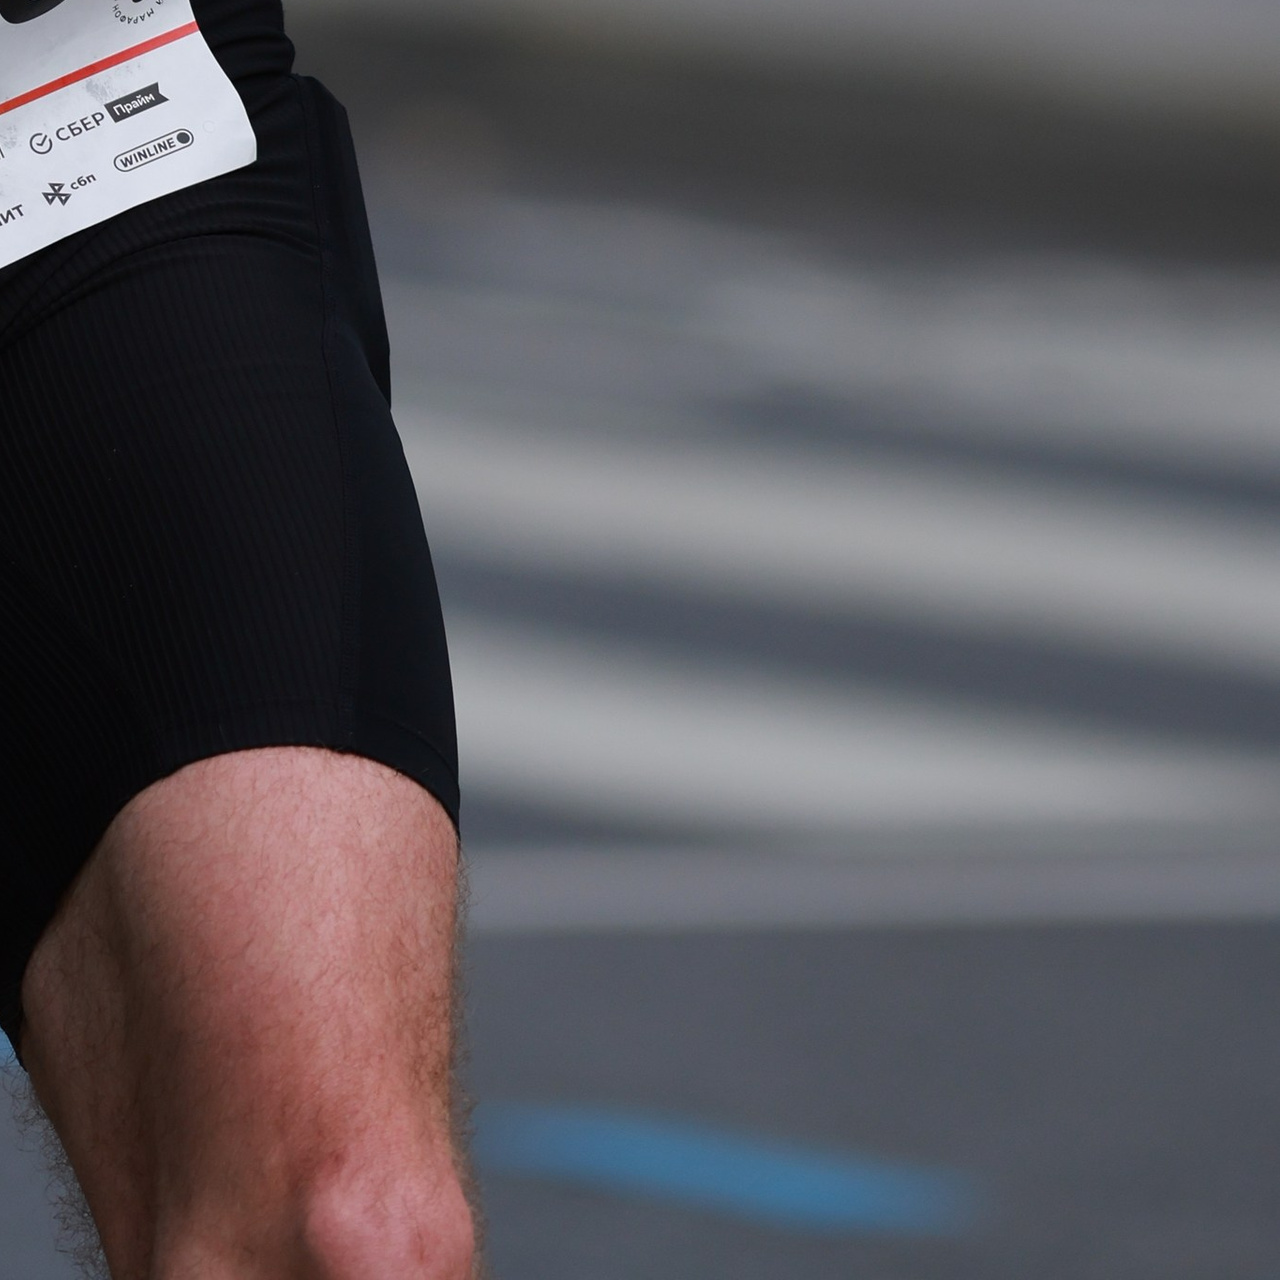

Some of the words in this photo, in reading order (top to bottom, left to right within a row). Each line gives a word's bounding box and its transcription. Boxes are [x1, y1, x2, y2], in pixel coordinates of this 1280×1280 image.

[112, 4, 154, 24] МАРАФОН
[55, 111, 105, 142] СБЕР
[112, 92, 156, 118] Прайм
[120, 137, 177, 169] WINLINE
[70, 173, 97, 191] сбп
